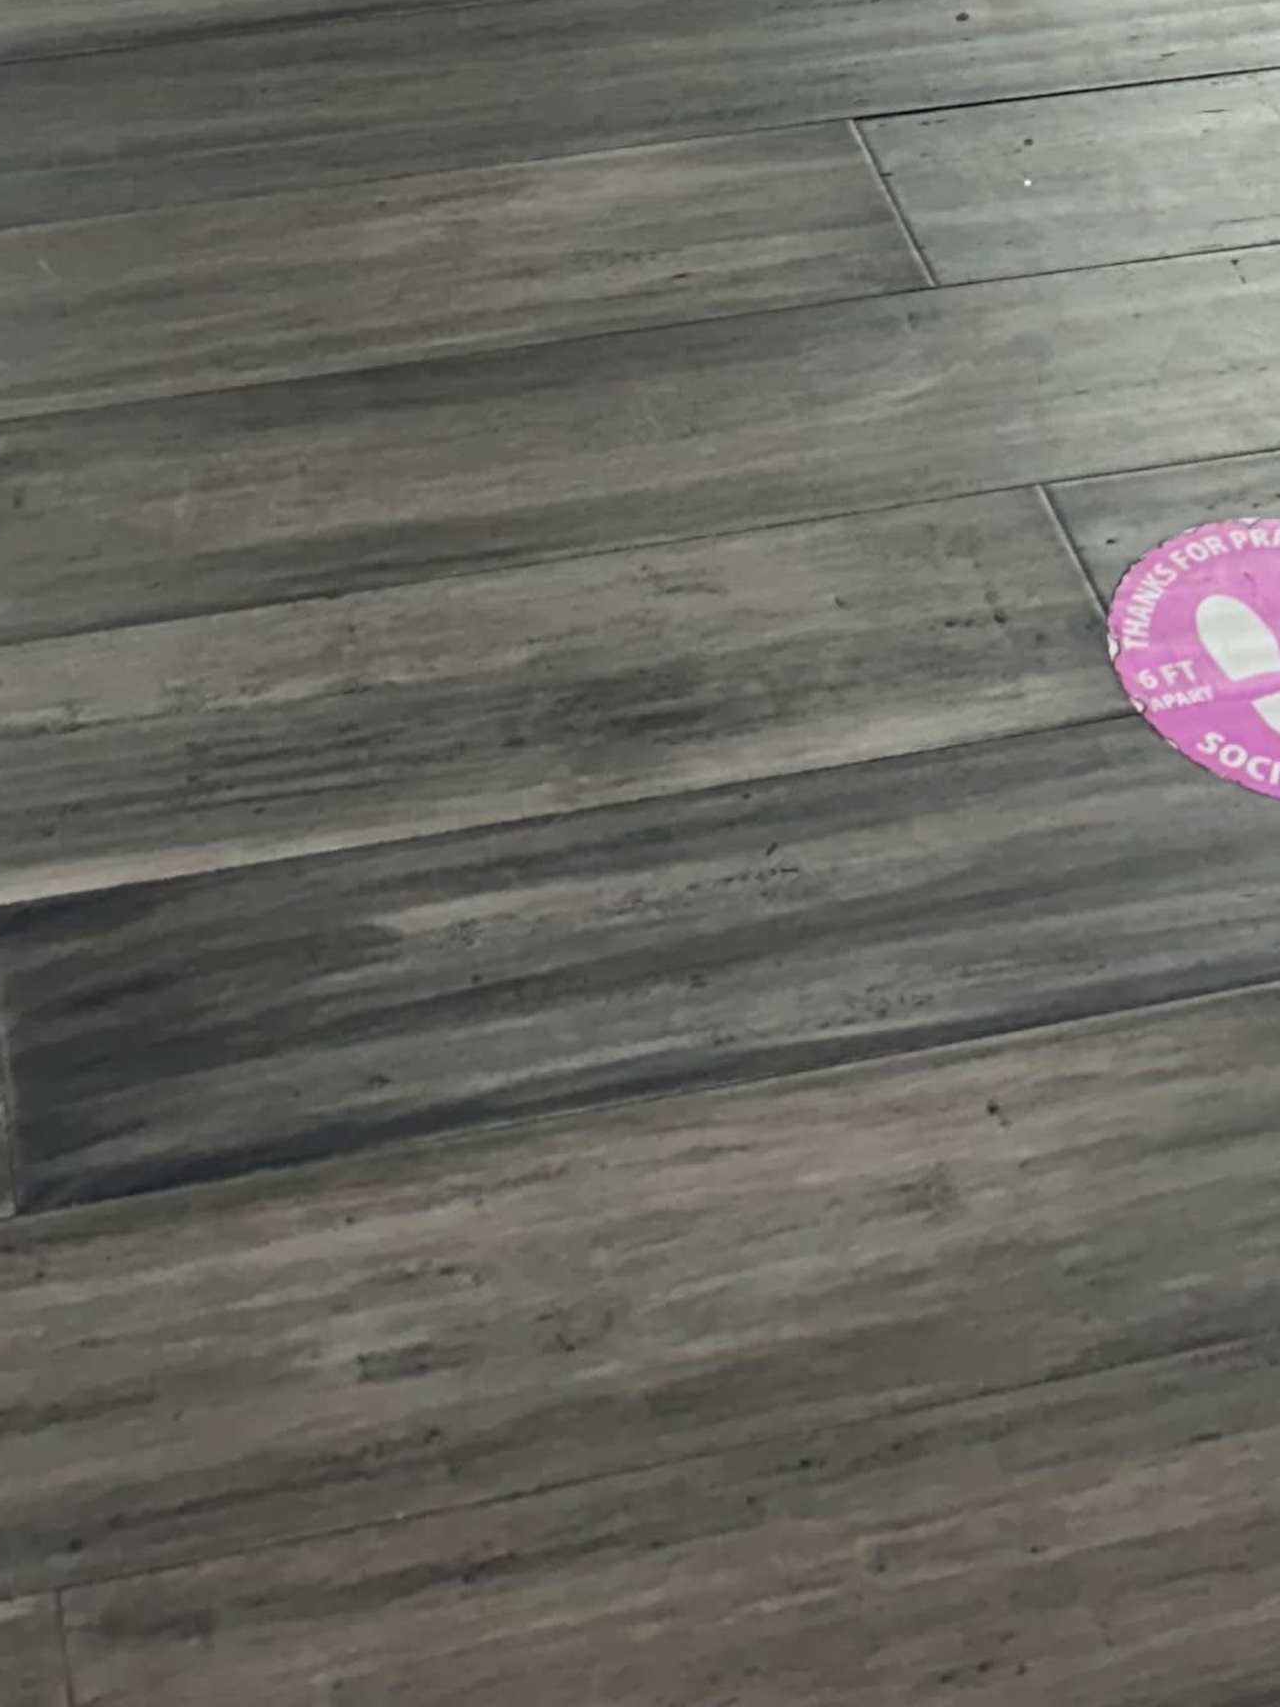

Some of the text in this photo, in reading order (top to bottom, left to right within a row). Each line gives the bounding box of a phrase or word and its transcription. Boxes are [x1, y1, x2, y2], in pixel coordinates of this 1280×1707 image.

[1121, 562, 1179, 650] THANKS
[1168, 535, 1231, 572] FOR
[1135, 659, 1197, 691] 6 FT
[1149, 684, 1216, 714] APART
